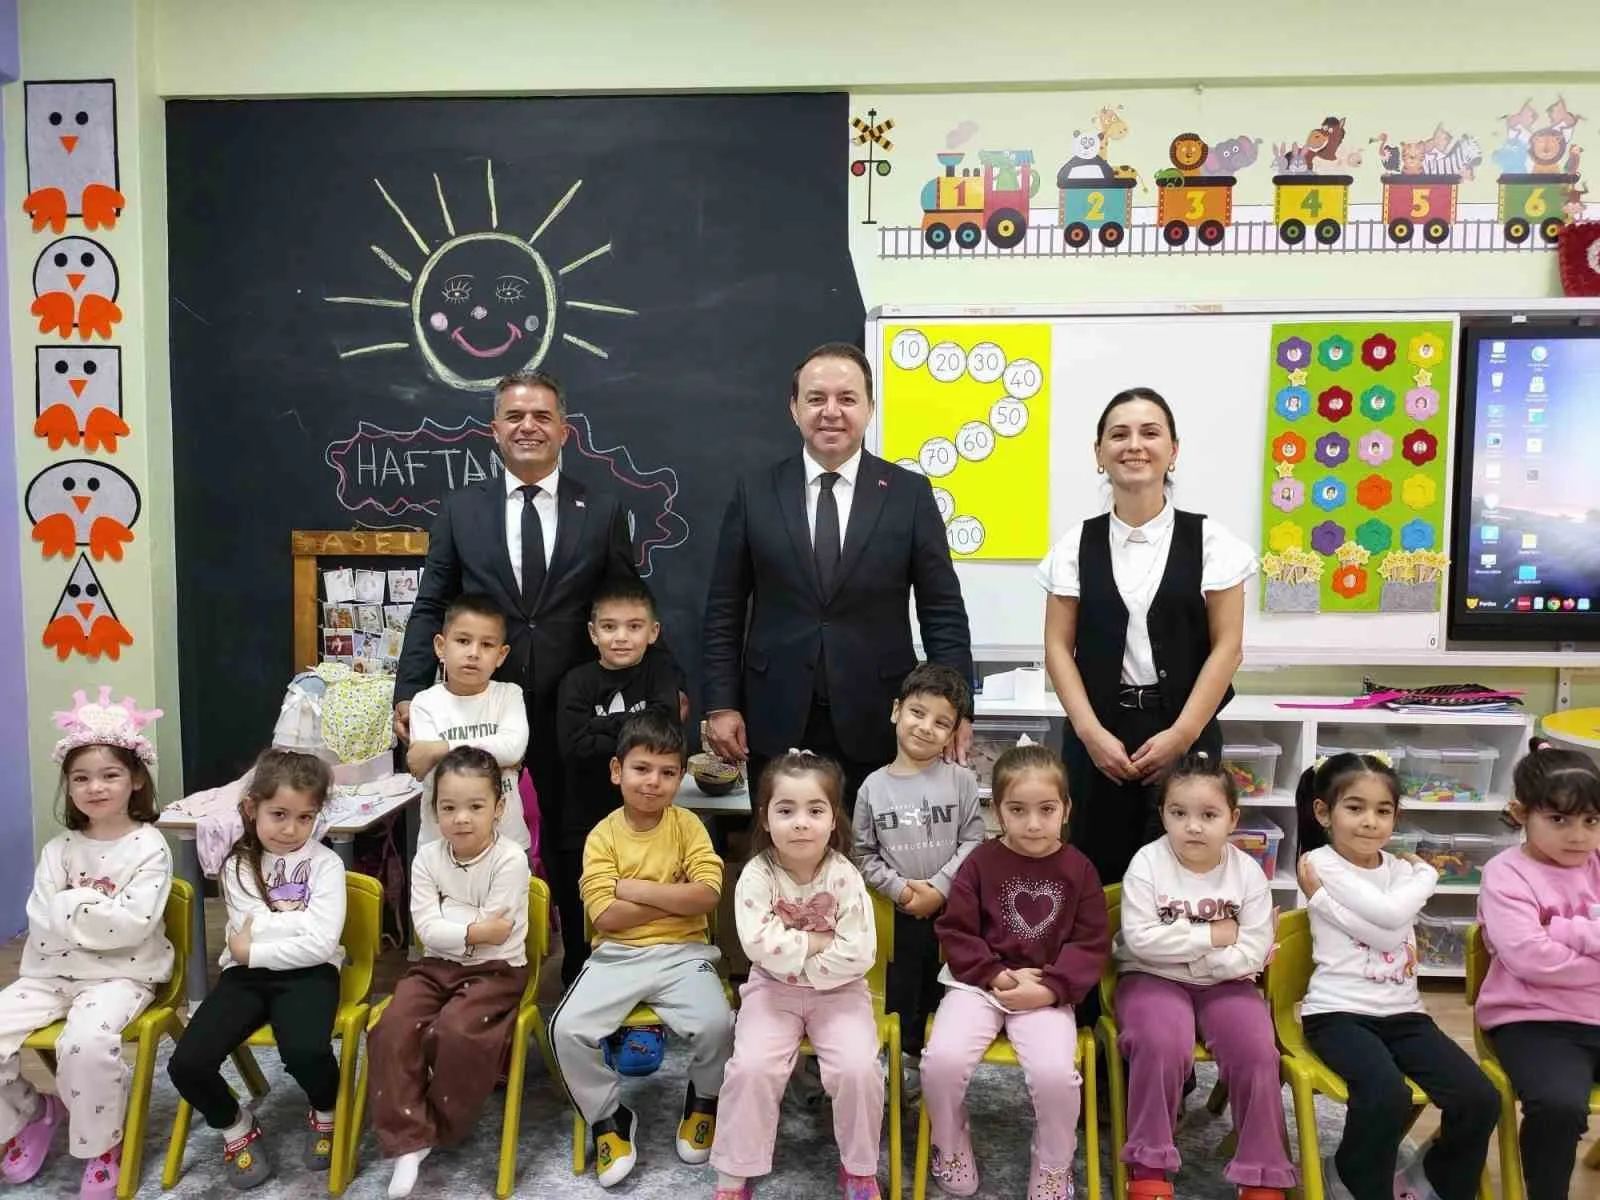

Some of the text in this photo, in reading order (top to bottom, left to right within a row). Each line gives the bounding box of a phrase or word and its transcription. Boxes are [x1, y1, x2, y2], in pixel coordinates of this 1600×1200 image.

[953, 180, 966, 208] 1
[1301, 189, 1322, 218] 4
[1410, 188, 1430, 218] 5
[1525, 188, 1547, 217] 6
[1085, 192, 1105, 220] 2
[1186, 191, 1205, 219] 3
[898, 339, 920, 360] 10
[936, 353, 960, 371] 20
[974, 352, 999, 371] 30
[1010, 369, 1036, 388] 40
[997, 407, 1021, 425] 50
[964, 431, 988, 452] 60
[927, 447, 949, 465] 70
[937, 497, 948, 514] 0
[948, 526, 983, 546] 100
